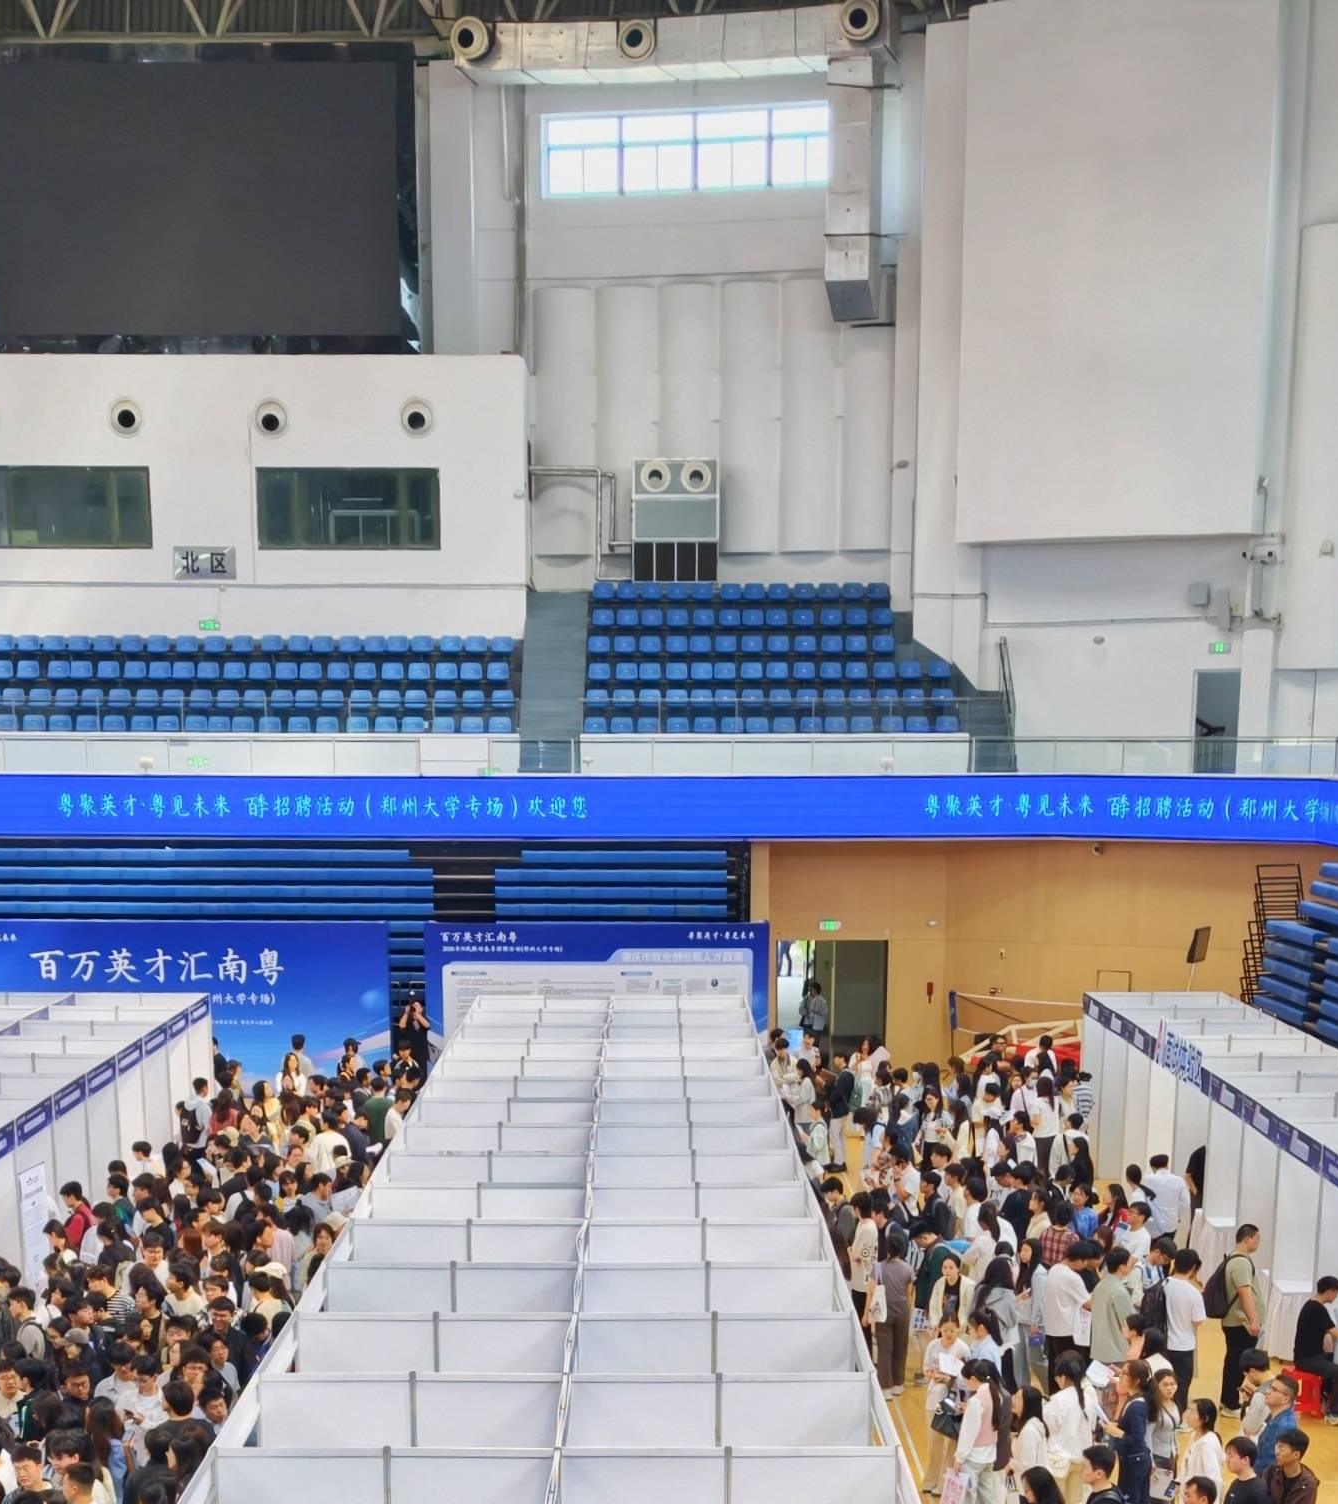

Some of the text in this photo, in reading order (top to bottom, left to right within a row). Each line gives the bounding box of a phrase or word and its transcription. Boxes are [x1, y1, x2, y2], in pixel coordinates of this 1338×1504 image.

[182, 552, 228, 574] 北区
[28, 947, 286, 987] 百万英才汇南粤
